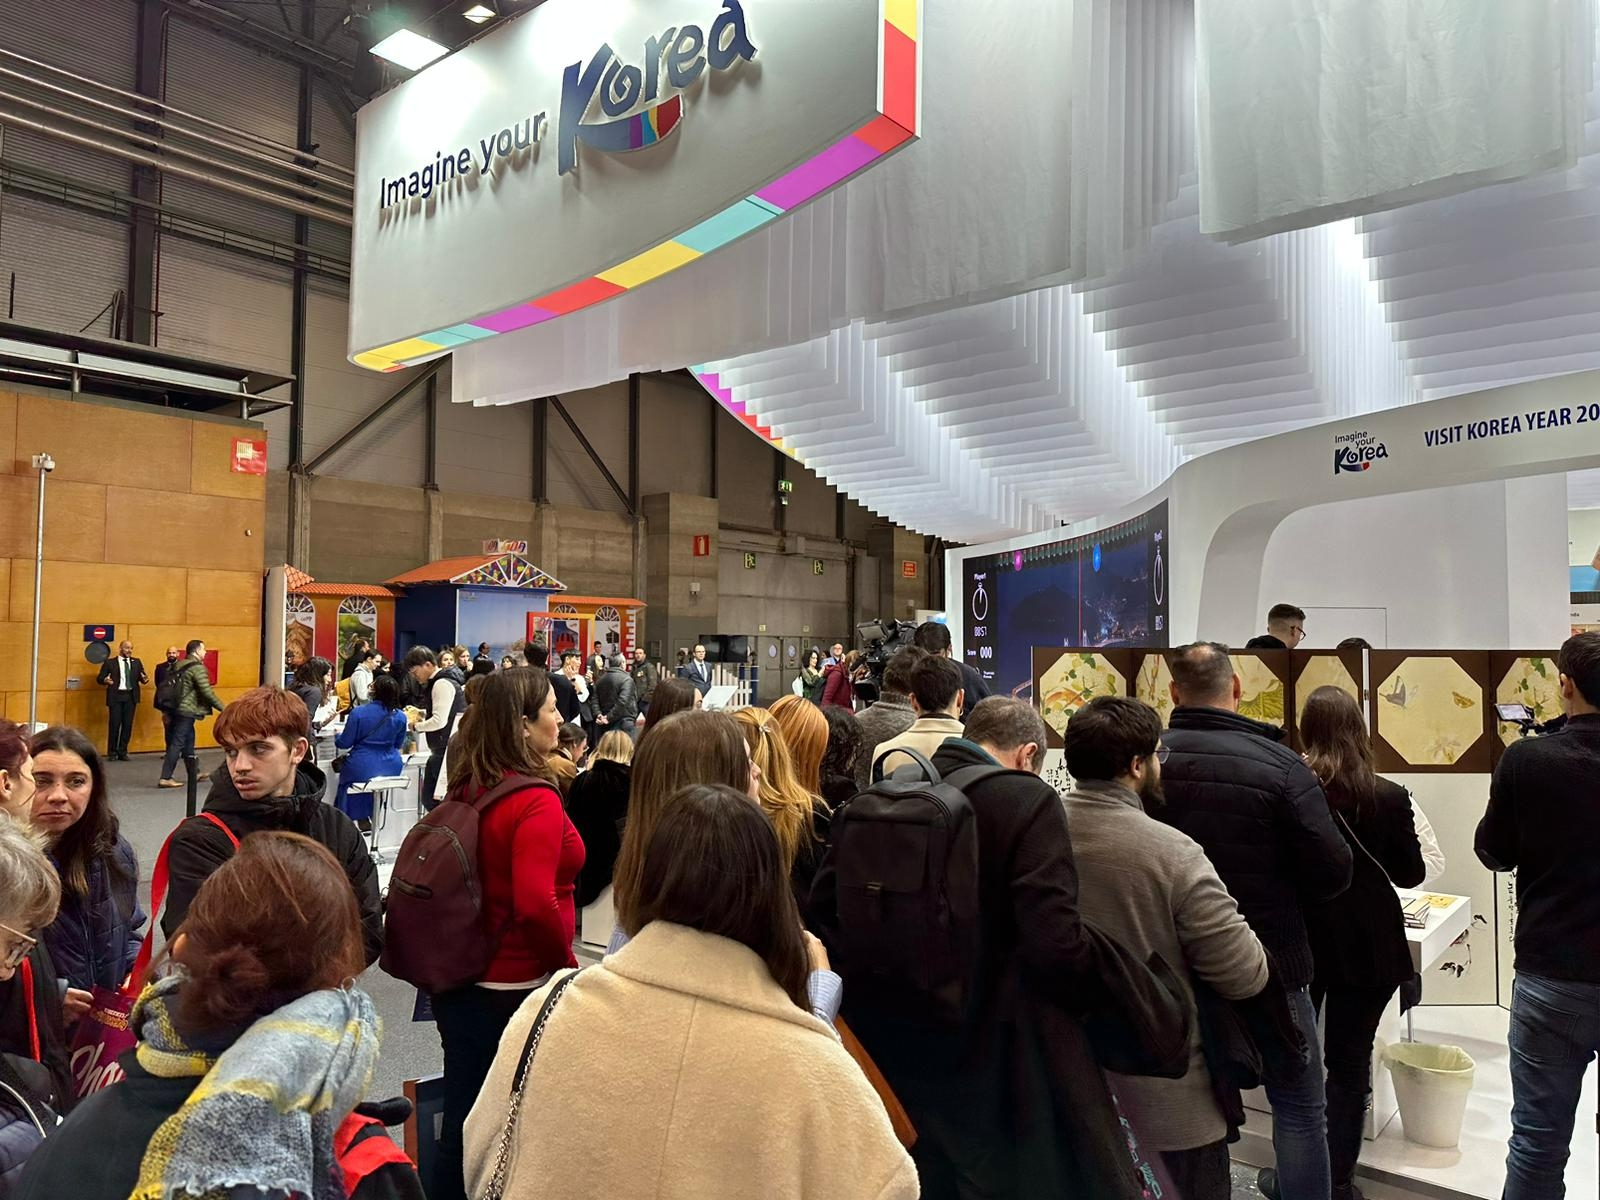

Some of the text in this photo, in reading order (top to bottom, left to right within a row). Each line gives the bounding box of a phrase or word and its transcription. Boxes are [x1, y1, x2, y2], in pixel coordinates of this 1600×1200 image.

[380, 0, 758, 210] Imagine your Korea
[1334, 431, 1368, 444] Imagine
[1355, 436, 1376, 449] your
[1424, 425, 1464, 448] VISIT
[1467, 415, 1522, 441] KOREA
[1525, 407, 1571, 431] YEAR
[1334, 442, 1389, 475] Korea
